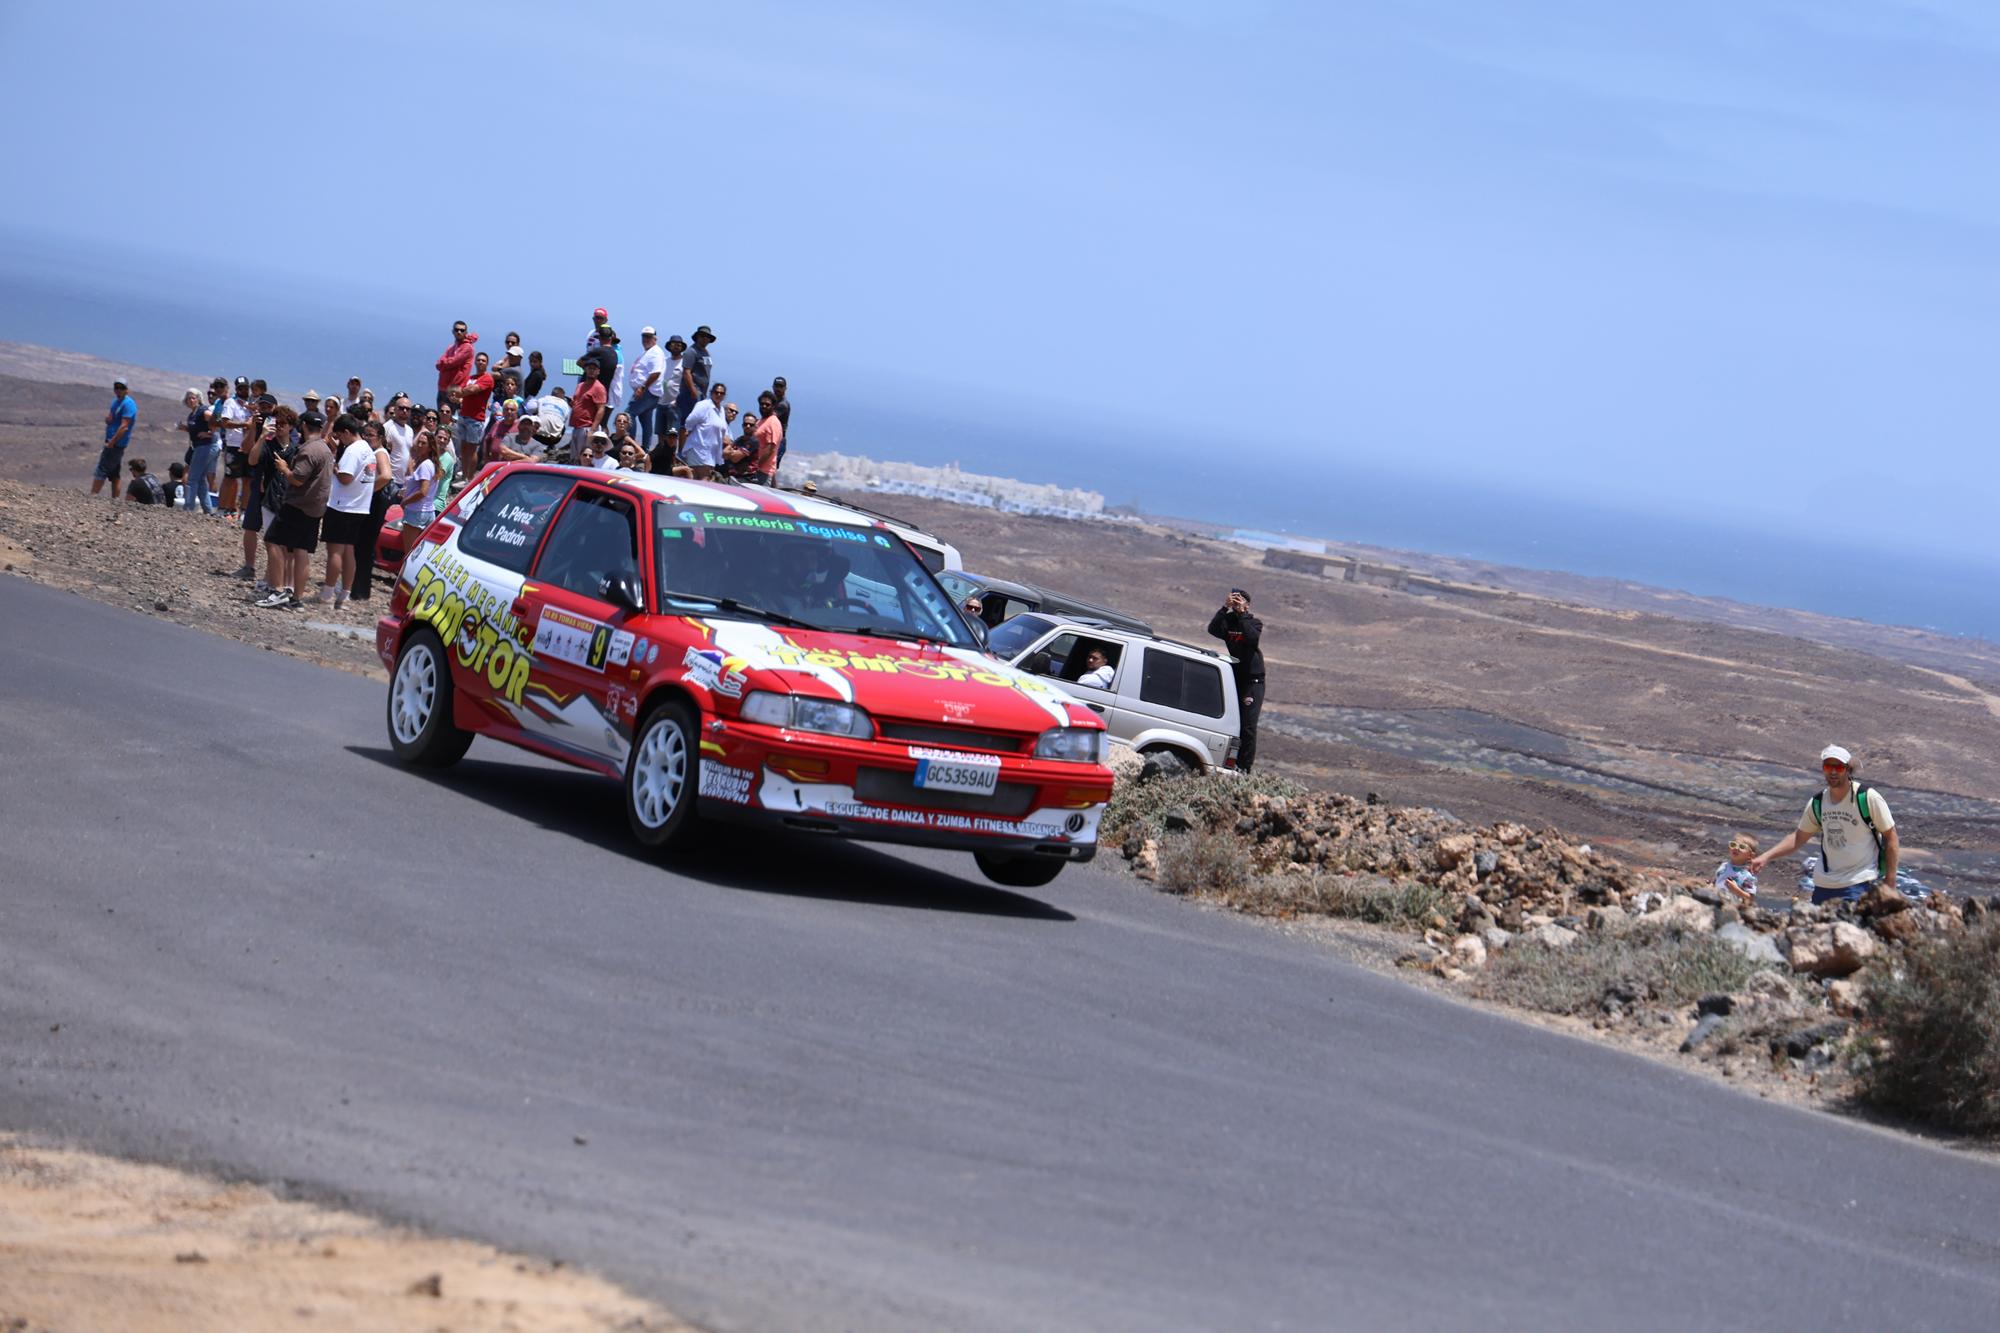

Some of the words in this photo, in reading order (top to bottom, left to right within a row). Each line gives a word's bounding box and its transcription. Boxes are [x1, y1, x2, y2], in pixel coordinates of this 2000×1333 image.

[498, 503, 510, 519] A.
[508, 506, 535, 525] Pérez
[486, 523, 498, 539] J.
[495, 526, 526, 547] Padrón
[796, 521, 869, 543] Teguise
[427, 544, 470, 591] TALLER
[592, 628, 607, 666] 9
[927, 765, 995, 788] GC5359AU
[874, 807, 889, 820] DE
[891, 808, 925, 825] DANZA
[928, 813, 935, 825] Y
[937, 814, 972, 829] ZUMBA
